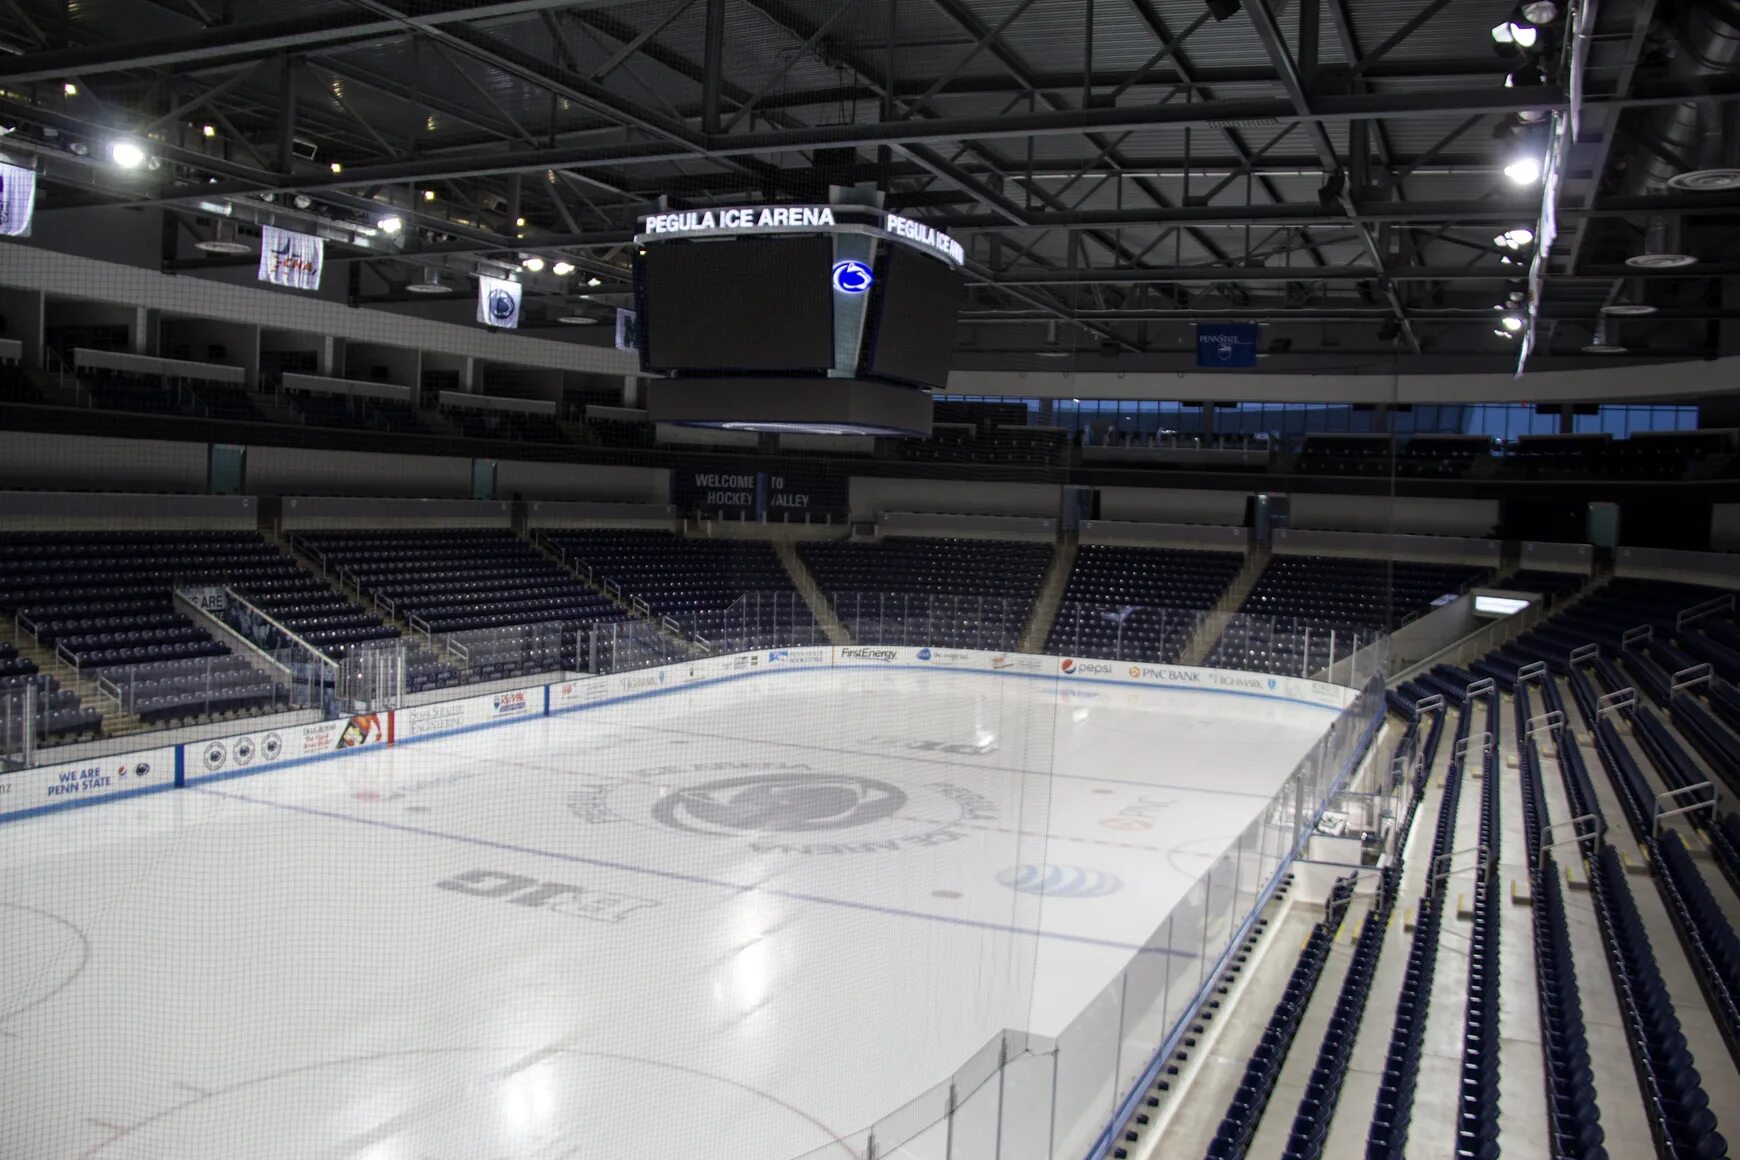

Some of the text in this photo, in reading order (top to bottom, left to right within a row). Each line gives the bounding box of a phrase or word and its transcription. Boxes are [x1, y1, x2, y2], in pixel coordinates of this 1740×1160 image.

[645, 207, 835, 233] PEGULA ICE ARENA
[887, 214, 936, 246] PEGULA
[695, 473, 784, 490] WELCOME TO
[706, 491, 753, 505] HOCKEY
[201, 595, 223, 608] ARE
[840, 647, 897, 661] FirstEnergy
[1078, 663, 1112, 674] pepsi
[1142, 668, 1200, 682] PNC BANK
[59, 767, 100, 783] WE ARE
[48, 776, 111, 796] PENN STATE
